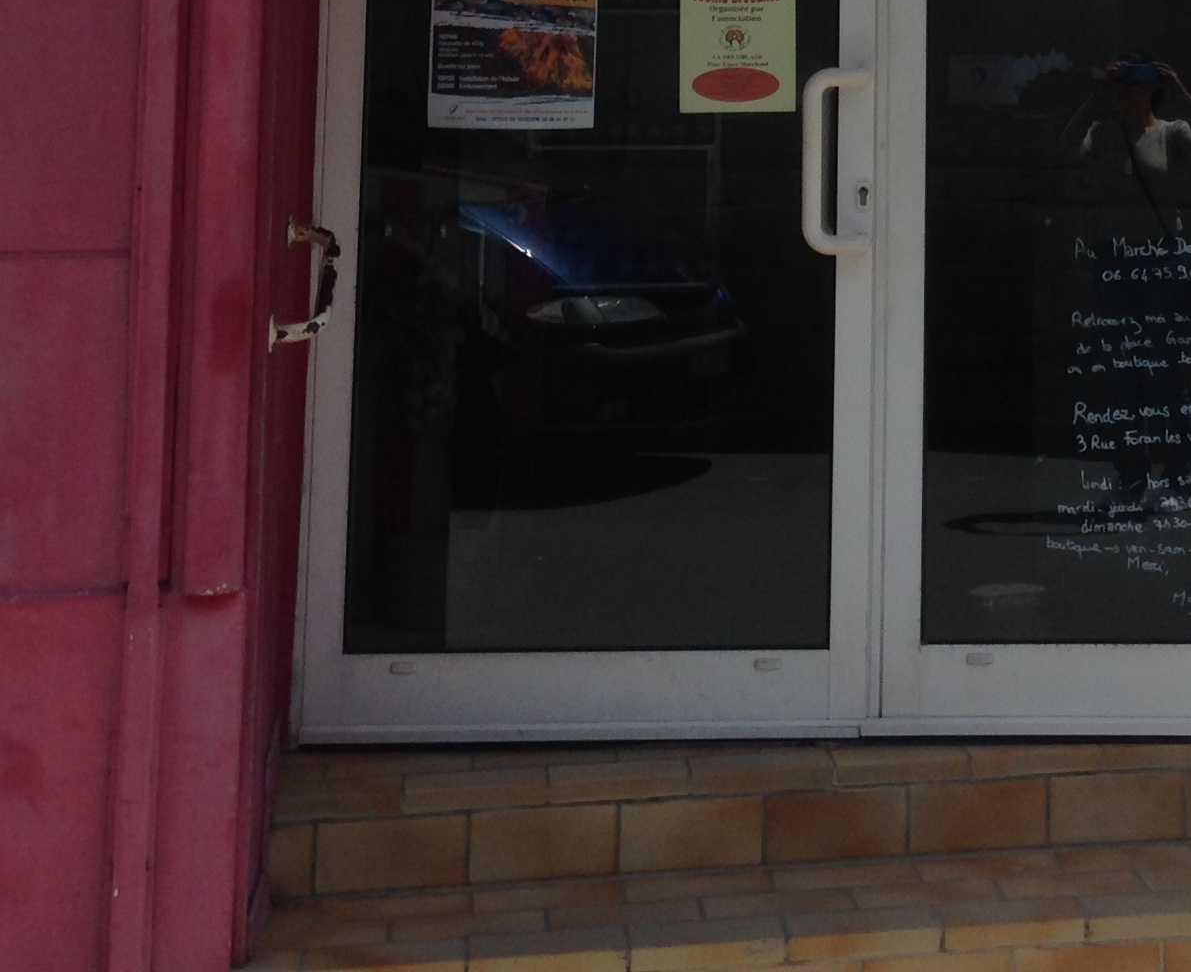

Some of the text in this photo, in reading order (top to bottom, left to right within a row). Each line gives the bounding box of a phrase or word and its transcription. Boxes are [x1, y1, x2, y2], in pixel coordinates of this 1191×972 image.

[1112, 236, 1169, 258] Marché
[1112, 354, 1170, 376] boutique
[1091, 436, 1117, 451] Rue
[1081, 518, 1143, 534] dimanche
